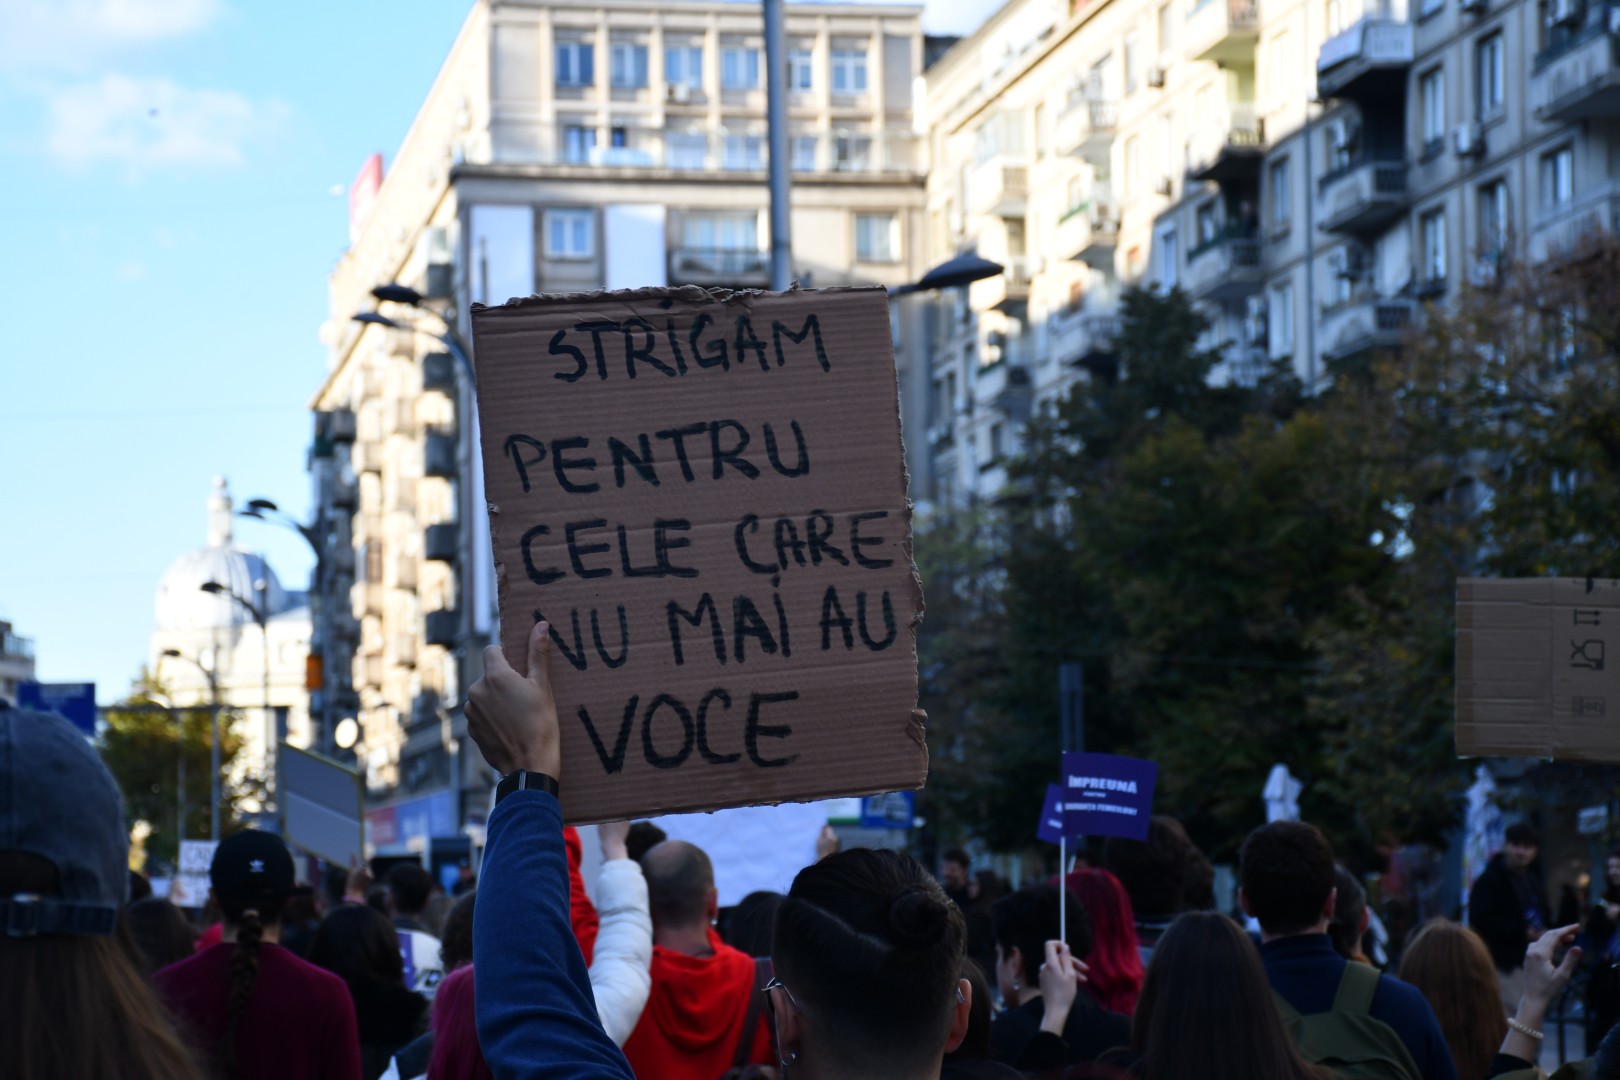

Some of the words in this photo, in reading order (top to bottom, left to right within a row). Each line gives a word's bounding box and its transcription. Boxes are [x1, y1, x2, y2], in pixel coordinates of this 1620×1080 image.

[548, 300, 832, 384] STRIGAM
[503, 418, 811, 494] PENTRU
[519, 517, 700, 585] CELE
[734, 509, 895, 577] CARE
[533, 604, 629, 671] NU
[665, 576, 791, 666] MAI
[819, 585, 898, 652] AU
[577, 688, 801, 774] VOCE
